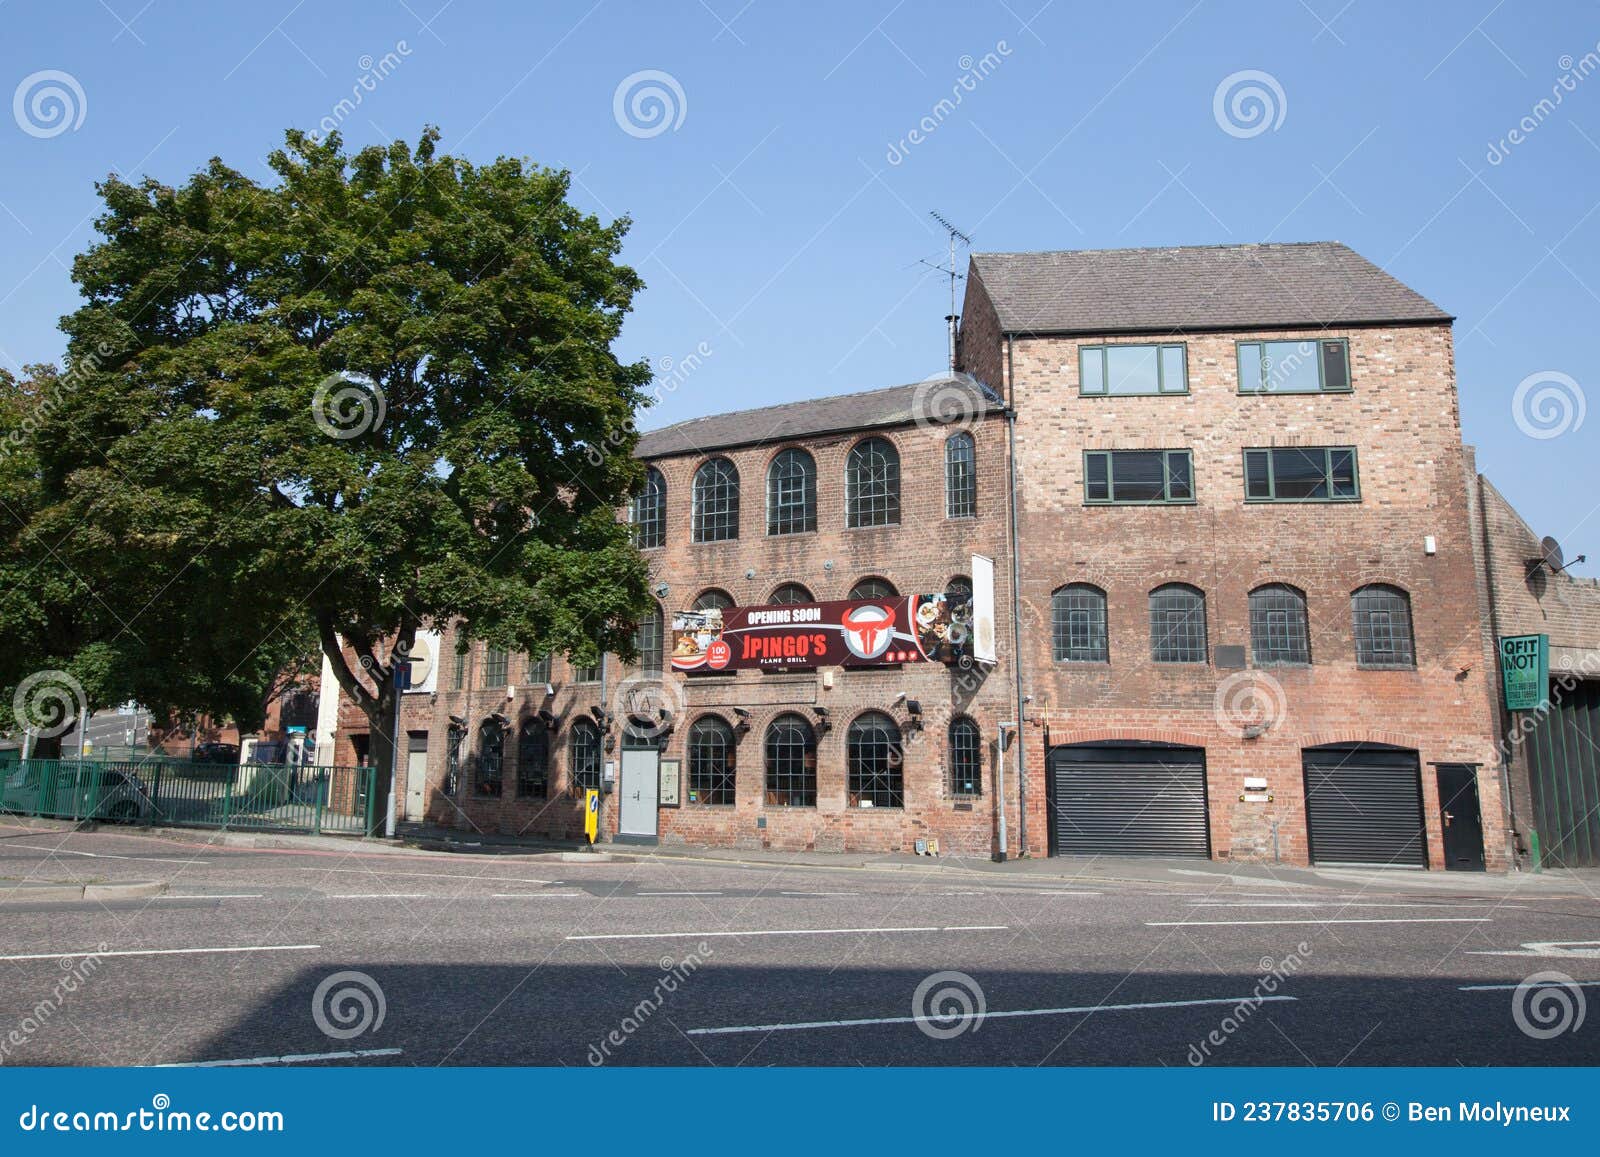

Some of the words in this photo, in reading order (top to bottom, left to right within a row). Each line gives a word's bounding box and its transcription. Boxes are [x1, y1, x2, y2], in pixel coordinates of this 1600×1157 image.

[748, 610, 791, 625] OPENING
[792, 608, 821, 622] SOON
[711, 646, 726, 655] 100
[742, 634, 827, 659] JPINGO'S
[1504, 640, 1537, 655] QFIT
[1504, 654, 1537, 670] MOT
